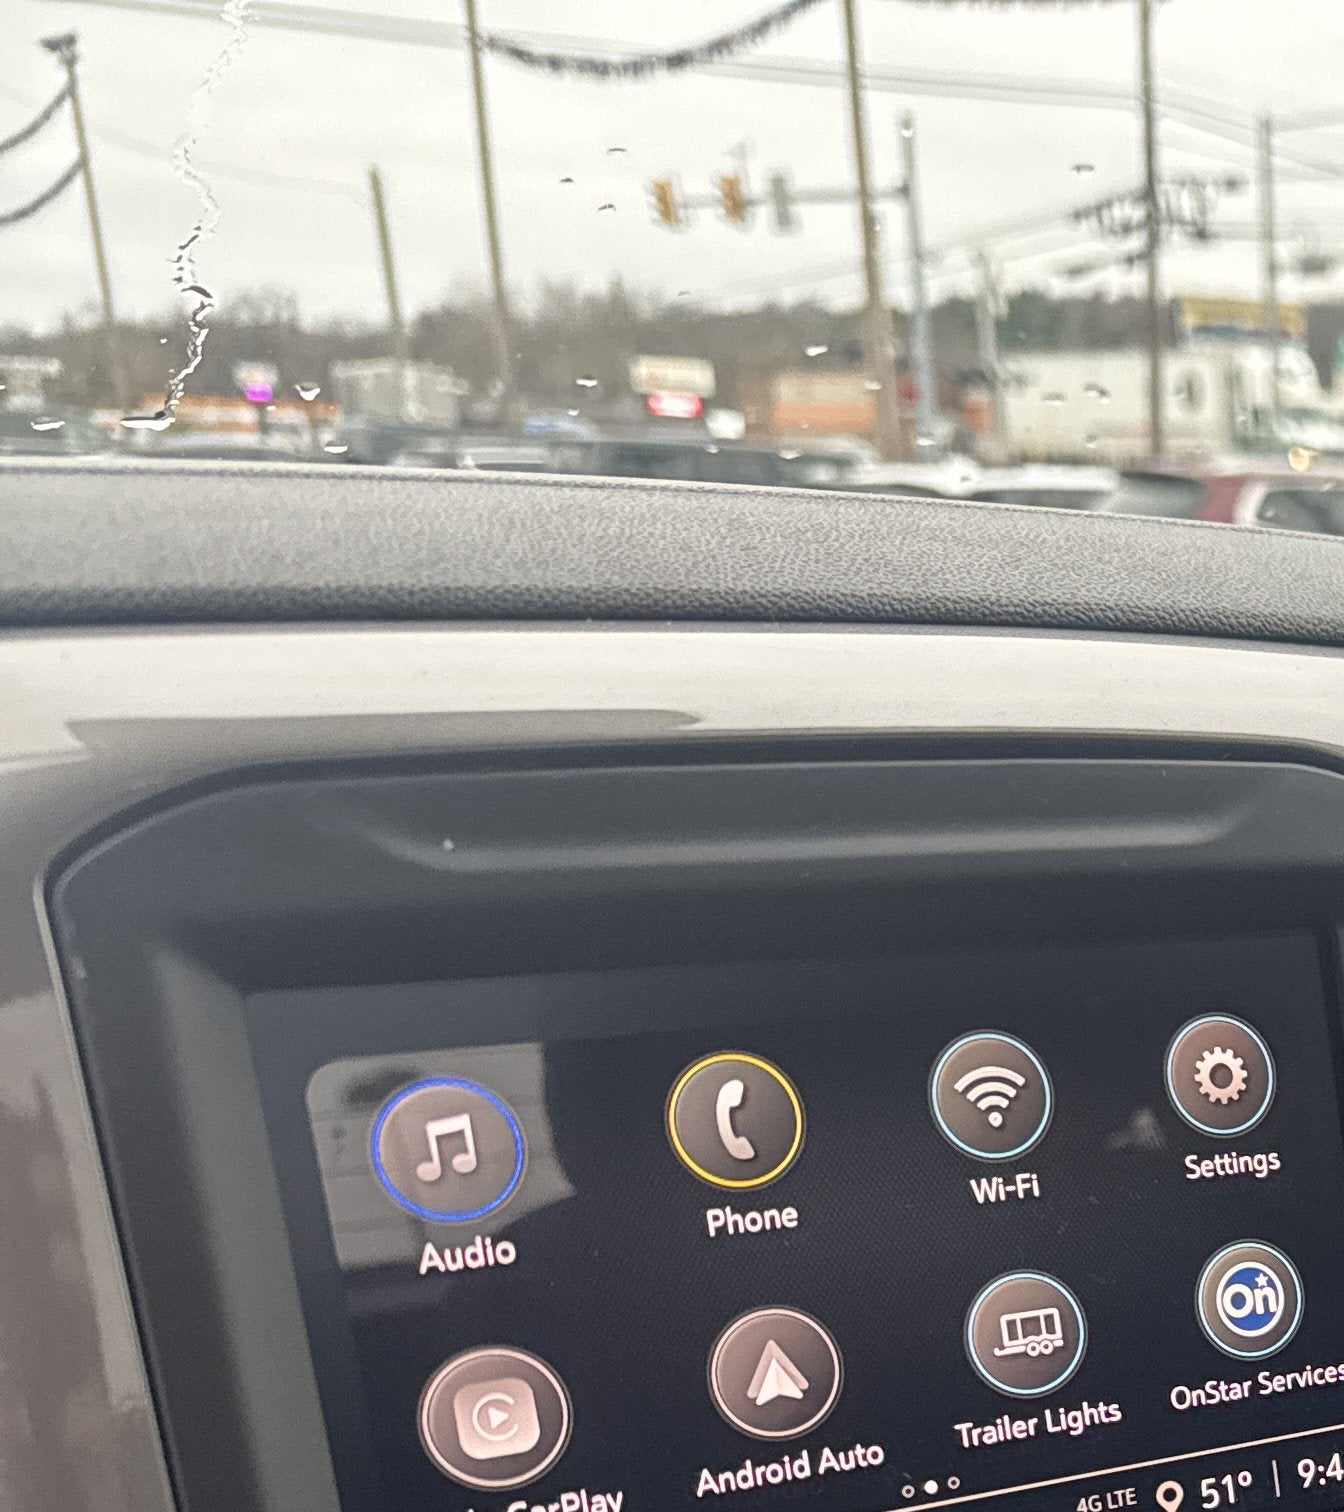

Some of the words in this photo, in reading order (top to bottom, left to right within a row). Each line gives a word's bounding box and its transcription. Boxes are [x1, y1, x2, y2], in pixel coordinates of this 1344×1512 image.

[1184, 1149, 1281, 1180] Settings
[970, 1173, 1040, 1204] Wi-Fi
[706, 1205, 799, 1237] Phone
[418, 1236, 516, 1275] Audio
[1170, 1378, 1252, 1410] OnStar
[954, 1416, 1040, 1449] Trailer
[1045, 1400, 1122, 1436] Lights
[696, 1452, 811, 1497] Android
[818, 1443, 884, 1476] Auto
[1107, 1487, 1137, 1510] LTE
